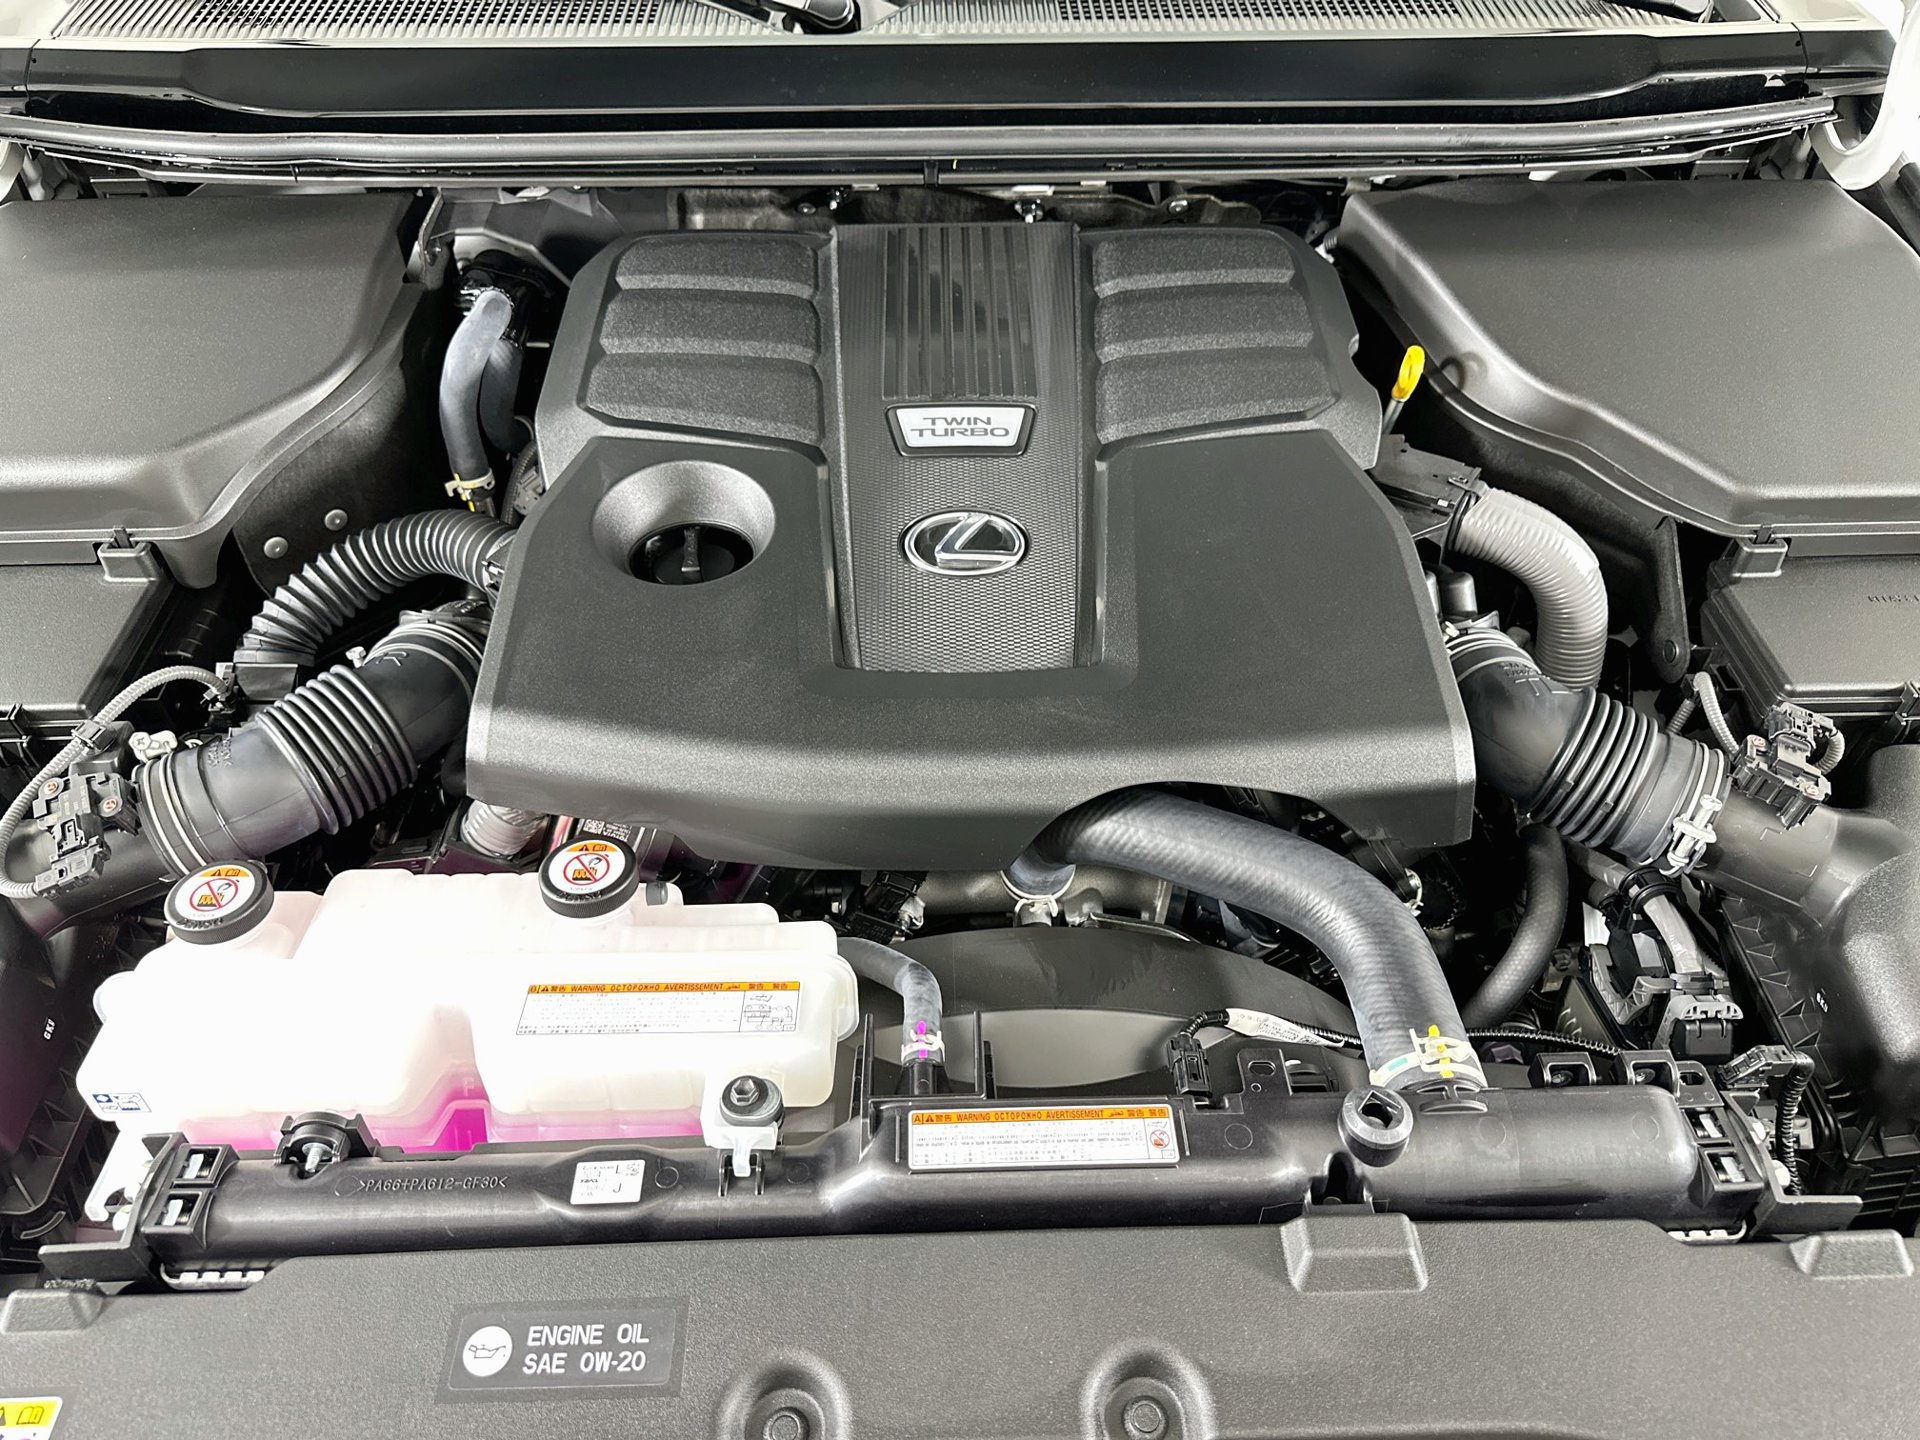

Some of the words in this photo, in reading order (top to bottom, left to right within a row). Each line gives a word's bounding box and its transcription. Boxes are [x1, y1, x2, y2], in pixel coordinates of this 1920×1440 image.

[922, 416, 992, 426] TWIN
[910, 427, 1010, 437] TURBO
[571, 984, 606, 992] WARNING
[664, 982, 723, 991] AVERTISSEMENT
[957, 1112, 991, 1122] WARNING
[1046, 1108, 1104, 1119] AVERTISSEMENT
[527, 1324, 605, 1347] ENGINE
[617, 1323, 650, 1344] OIL
[522, 1353, 568, 1375] SAE
[579, 1350, 647, 1373] 0W-20
